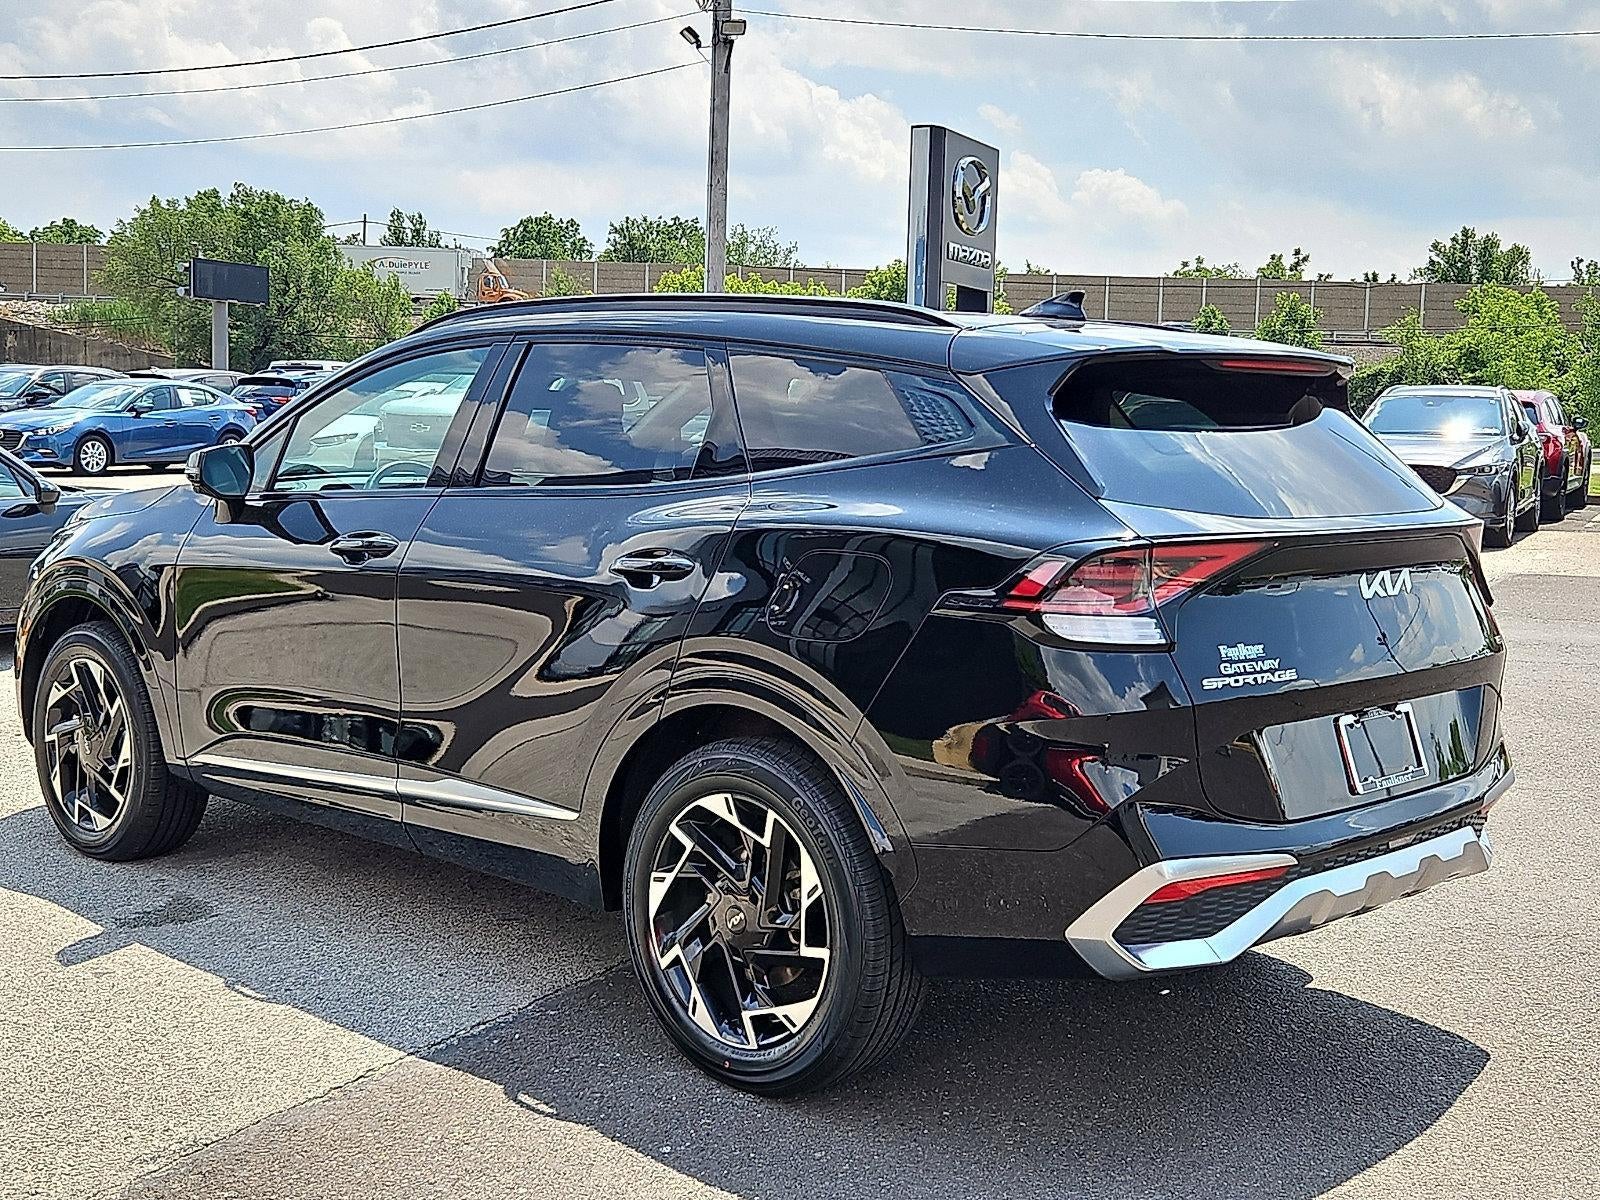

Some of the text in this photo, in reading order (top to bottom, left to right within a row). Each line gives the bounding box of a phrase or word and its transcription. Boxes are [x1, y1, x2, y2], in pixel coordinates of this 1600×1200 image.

[1220, 658, 1280, 675] GATEWAY
[1202, 669, 1299, 690] SPORTAGE
[1376, 774, 1413, 788] Faulkner
